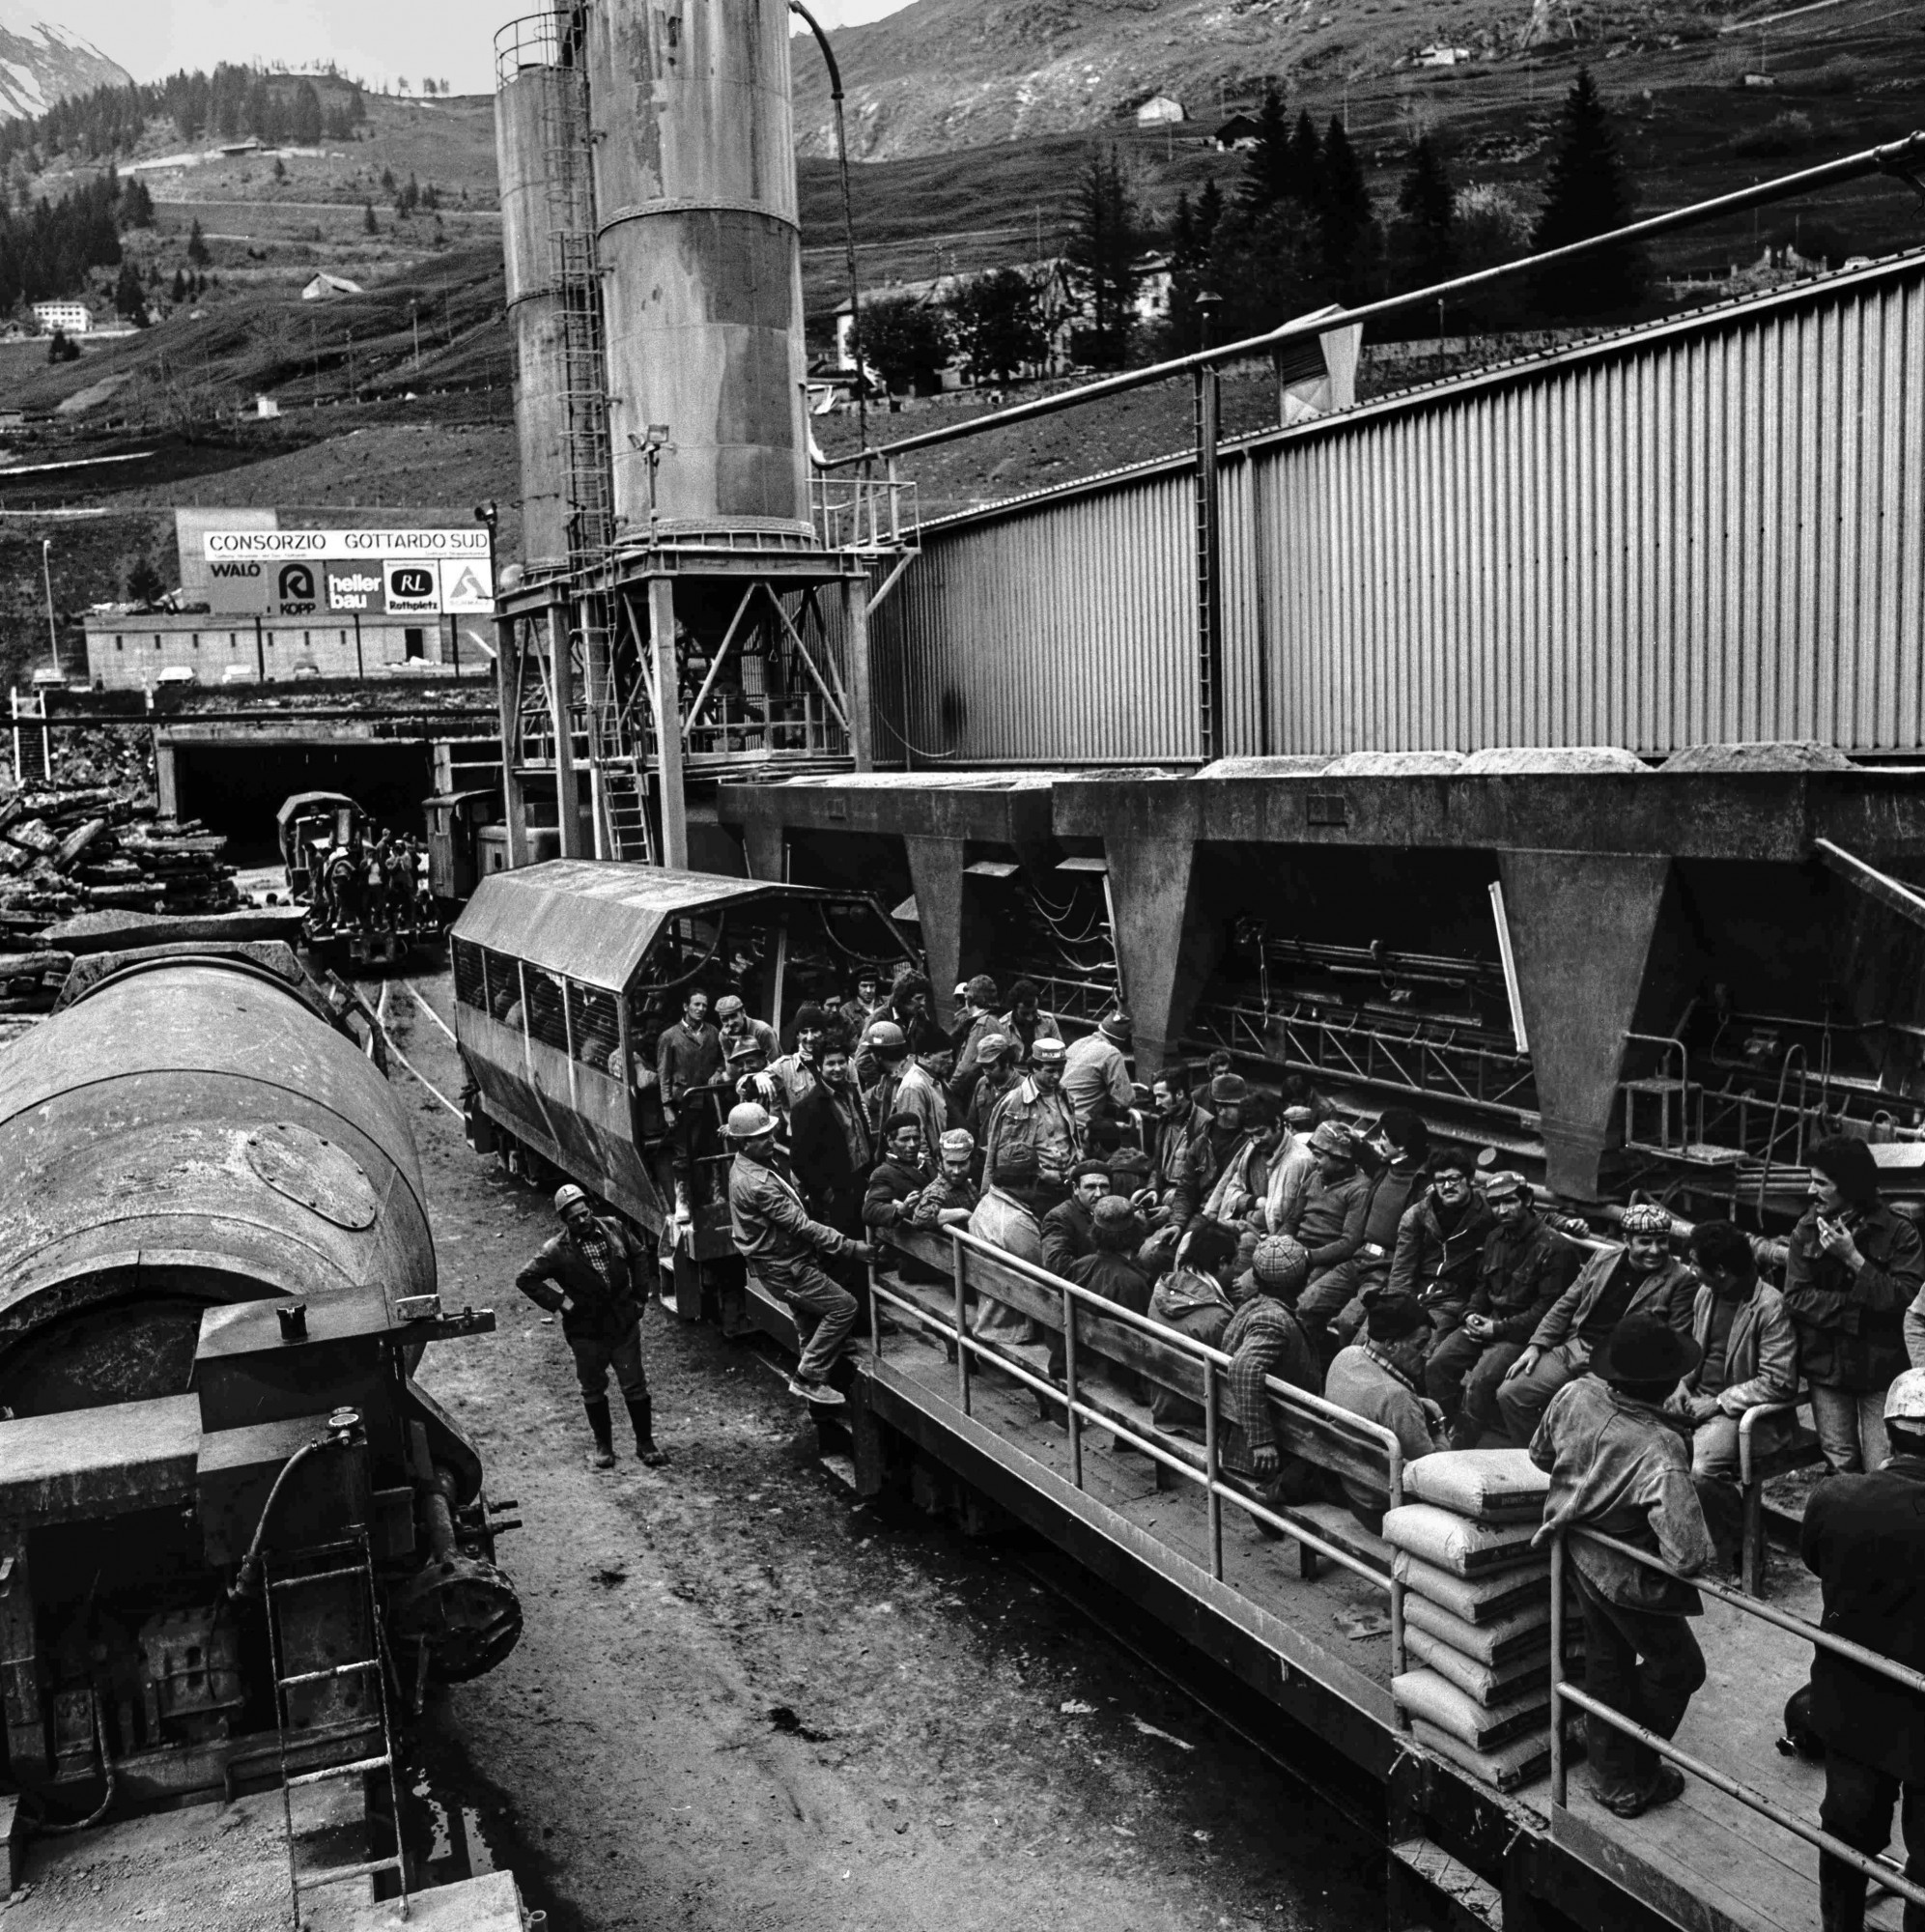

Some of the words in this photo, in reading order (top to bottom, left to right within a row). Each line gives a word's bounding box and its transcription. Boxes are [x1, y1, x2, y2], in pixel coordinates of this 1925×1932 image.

[210, 534, 326, 551] CONSORZIO
[345, 532, 446, 549] GOTTARDO
[450, 532, 488, 549] SUD
[328, 573, 382, 592] heller
[280, 602, 316, 615] KOPP
[329, 591, 367, 610] bau
[389, 600, 438, 611] Rothpletz
